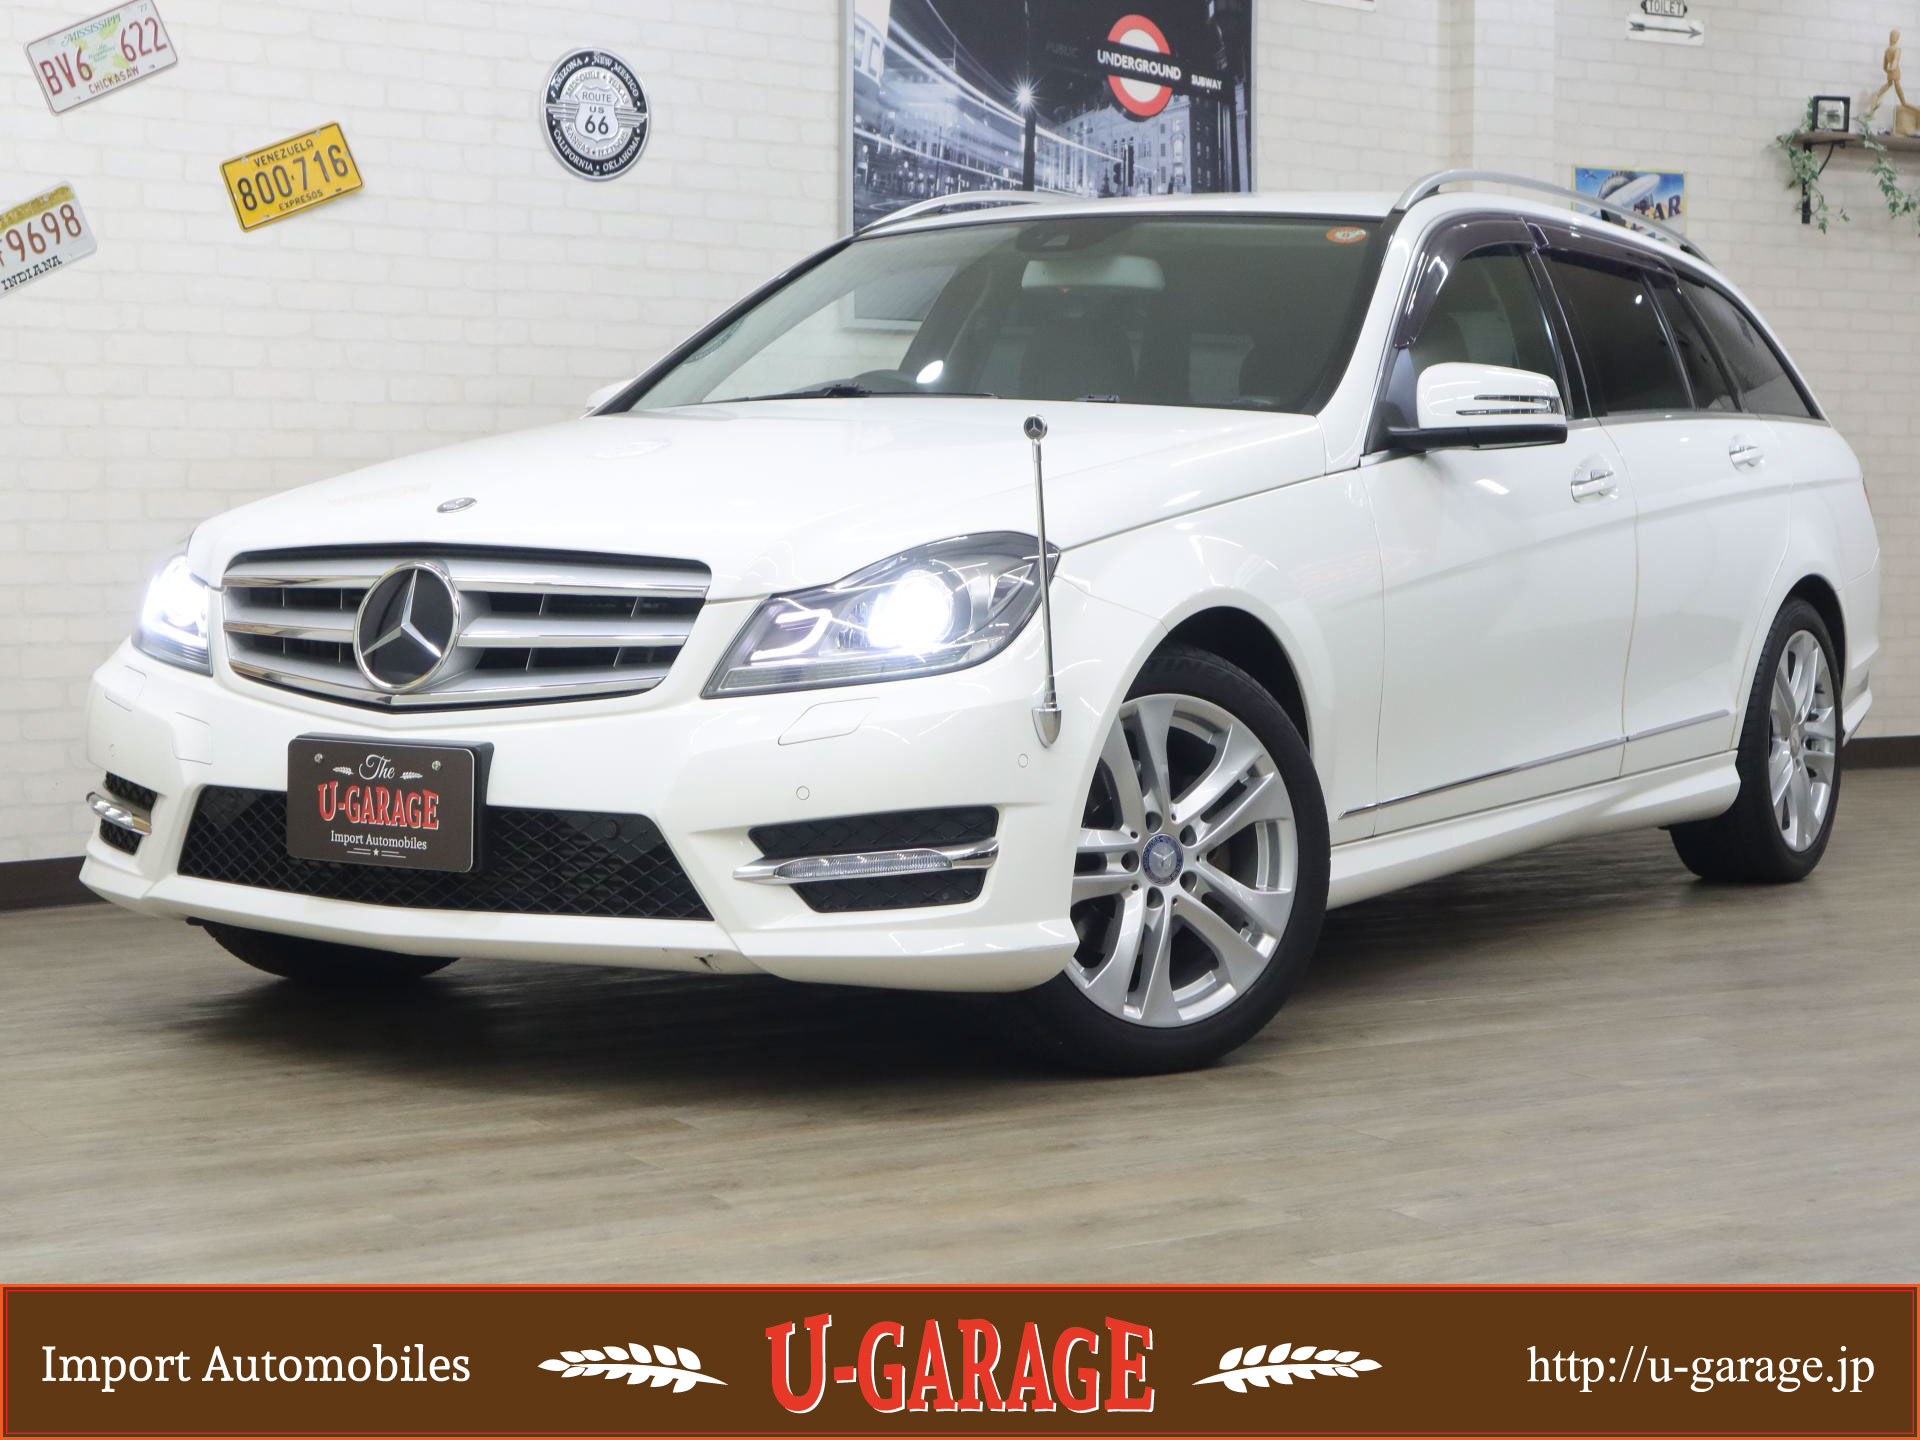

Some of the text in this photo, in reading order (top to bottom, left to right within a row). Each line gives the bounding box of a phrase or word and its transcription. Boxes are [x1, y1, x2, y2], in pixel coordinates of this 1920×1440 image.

[1647, 0, 1683, 14] TOILET
[61, 13, 121, 47] MISSISSIPPI
[39, 47, 93, 96] BV6
[120, 17, 168, 62] 622
[1097, 49, 1181, 80] UNDERGROUND
[88, 66, 139, 94] CHICKASAW
[554, 57, 583, 91] ARIZONA
[592, 55, 639, 97] NEW MEXICO
[1191, 74, 1222, 90] SUBWAY
[582, 91, 612, 103] ROUTE
[589, 105, 605, 113] US
[584, 114, 609, 135] 66
[254, 139, 314, 168] VENEZUELA
[553, 128, 594, 172] CALIFORNIA
[602, 136, 641, 172] OKLAHOMA
[278, 188, 324, 211] EXPRESOS
[0, 204, 82, 268] 9698
[1, 255, 62, 290] INDIANA
[358, 754, 395, 781] The
[318, 780, 440, 831] U-GARAGE
[331, 830, 427, 850] Import Automobiles
